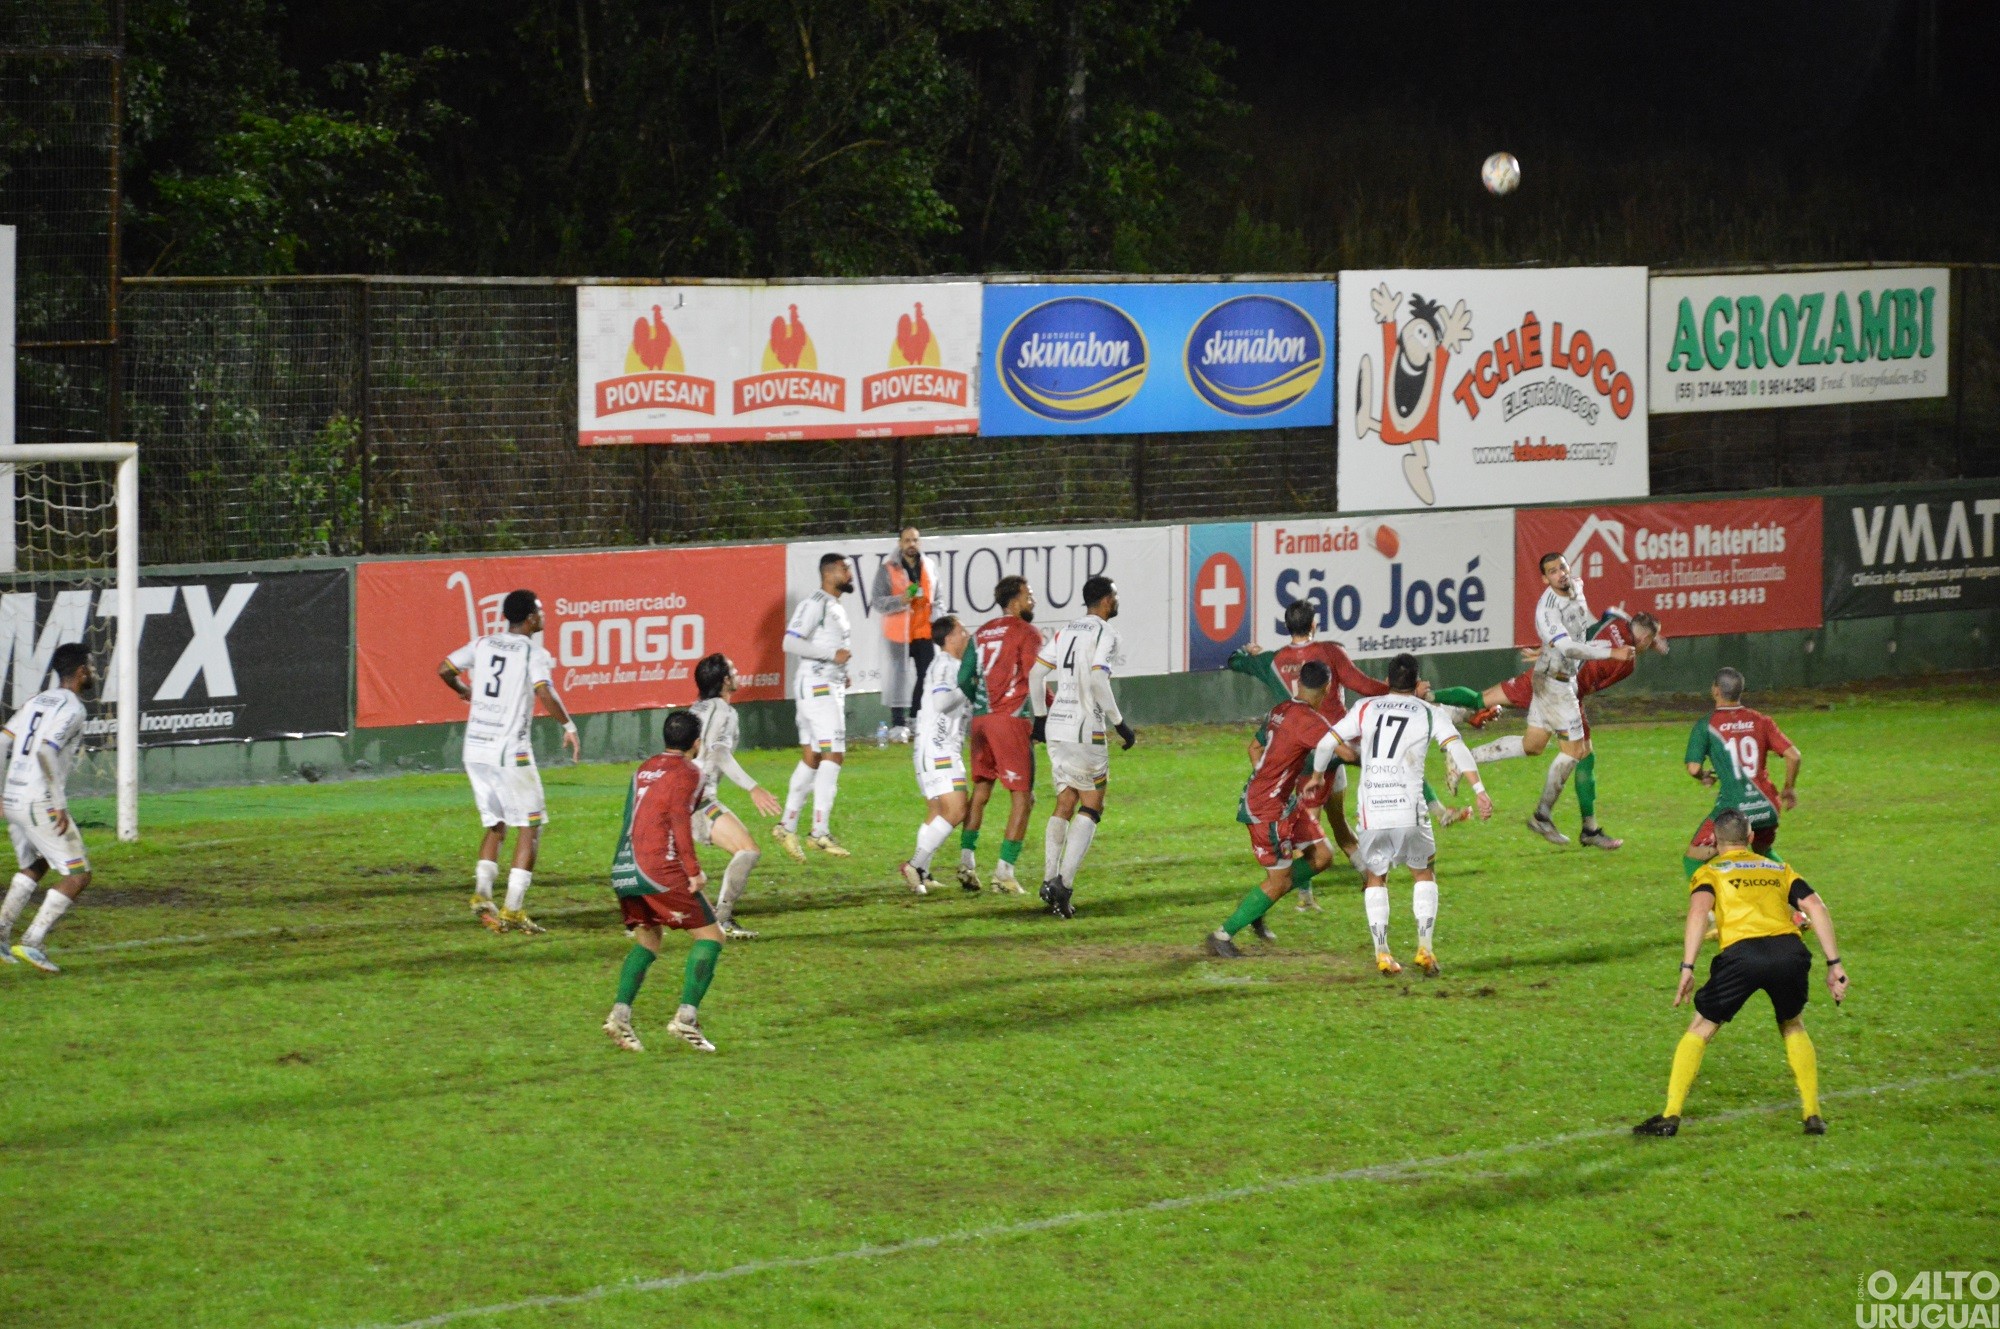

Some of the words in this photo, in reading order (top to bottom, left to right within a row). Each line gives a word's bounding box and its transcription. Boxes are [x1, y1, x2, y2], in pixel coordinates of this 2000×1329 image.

[1667, 286, 1936, 372] AGROZAMBI
[1453, 311, 1543, 420] TCHÊ
[1551, 321, 1634, 420] LOCO
[605, 379, 707, 409] PIOVESAN
[743, 378, 838, 407] PIOVESAN
[870, 374, 961, 402] PIOVESAN
[1502, 376, 1600, 425] ELETRÔNICOS
[1275, 525, 1358, 555] Farmácia
[1635, 527, 1689, 561] Costa
[1694, 520, 1786, 556] Materiais
[555, 593, 687, 618] Supermercado
[1275, 567, 1361, 636] São
[1379, 555, 1486, 628] José
[1655, 593, 1674, 610] 55
[1676, 592, 1687, 609] 9
[1729, 587, 1766, 606] 4343
[975, 641, 1003, 676] 17
[1063, 636, 1077, 676] 4
[485, 655, 506, 698] 3
[140, 708, 234, 734] Incorporadora
[1372, 714, 1409, 759] 17
[1365, 764, 1398, 775] PONTO
[1725, 736, 1758, 780] 19
